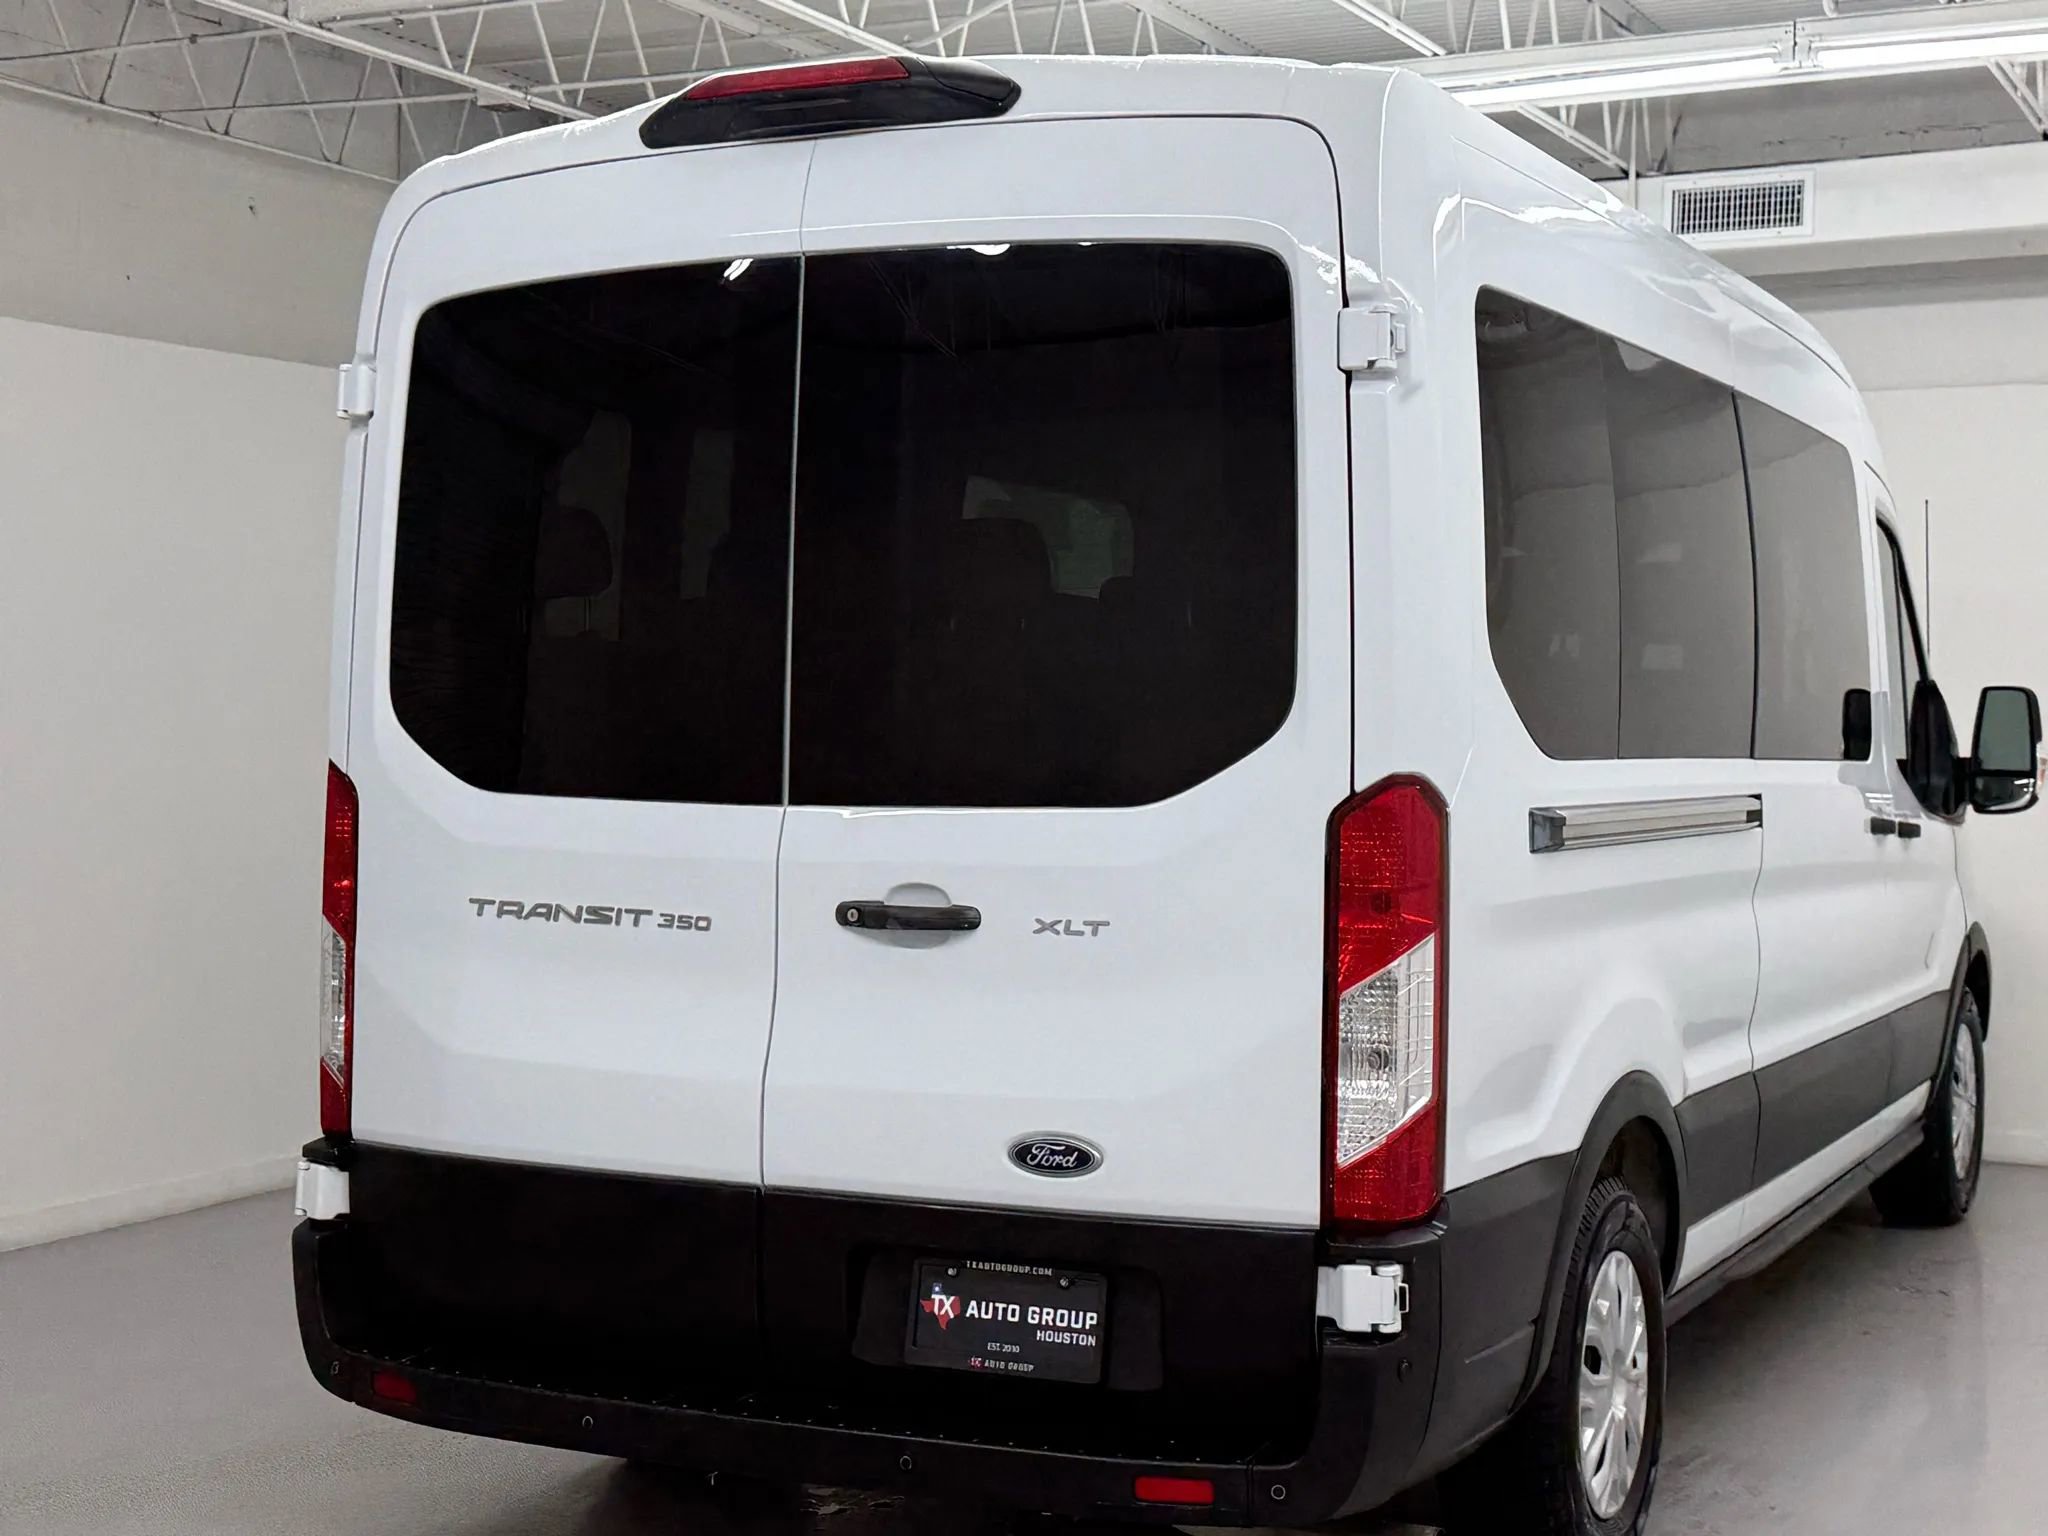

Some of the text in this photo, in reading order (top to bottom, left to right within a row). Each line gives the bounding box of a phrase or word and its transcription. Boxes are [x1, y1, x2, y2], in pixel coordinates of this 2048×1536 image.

[469, 898, 712, 931] TRANSIT 350
[1032, 918, 1110, 937] XLT
[1026, 1143, 1078, 1168] Ford
[931, 1294, 1098, 1330] TX AUTO GROUP
[1036, 1329, 1097, 1347] HOUSTON
